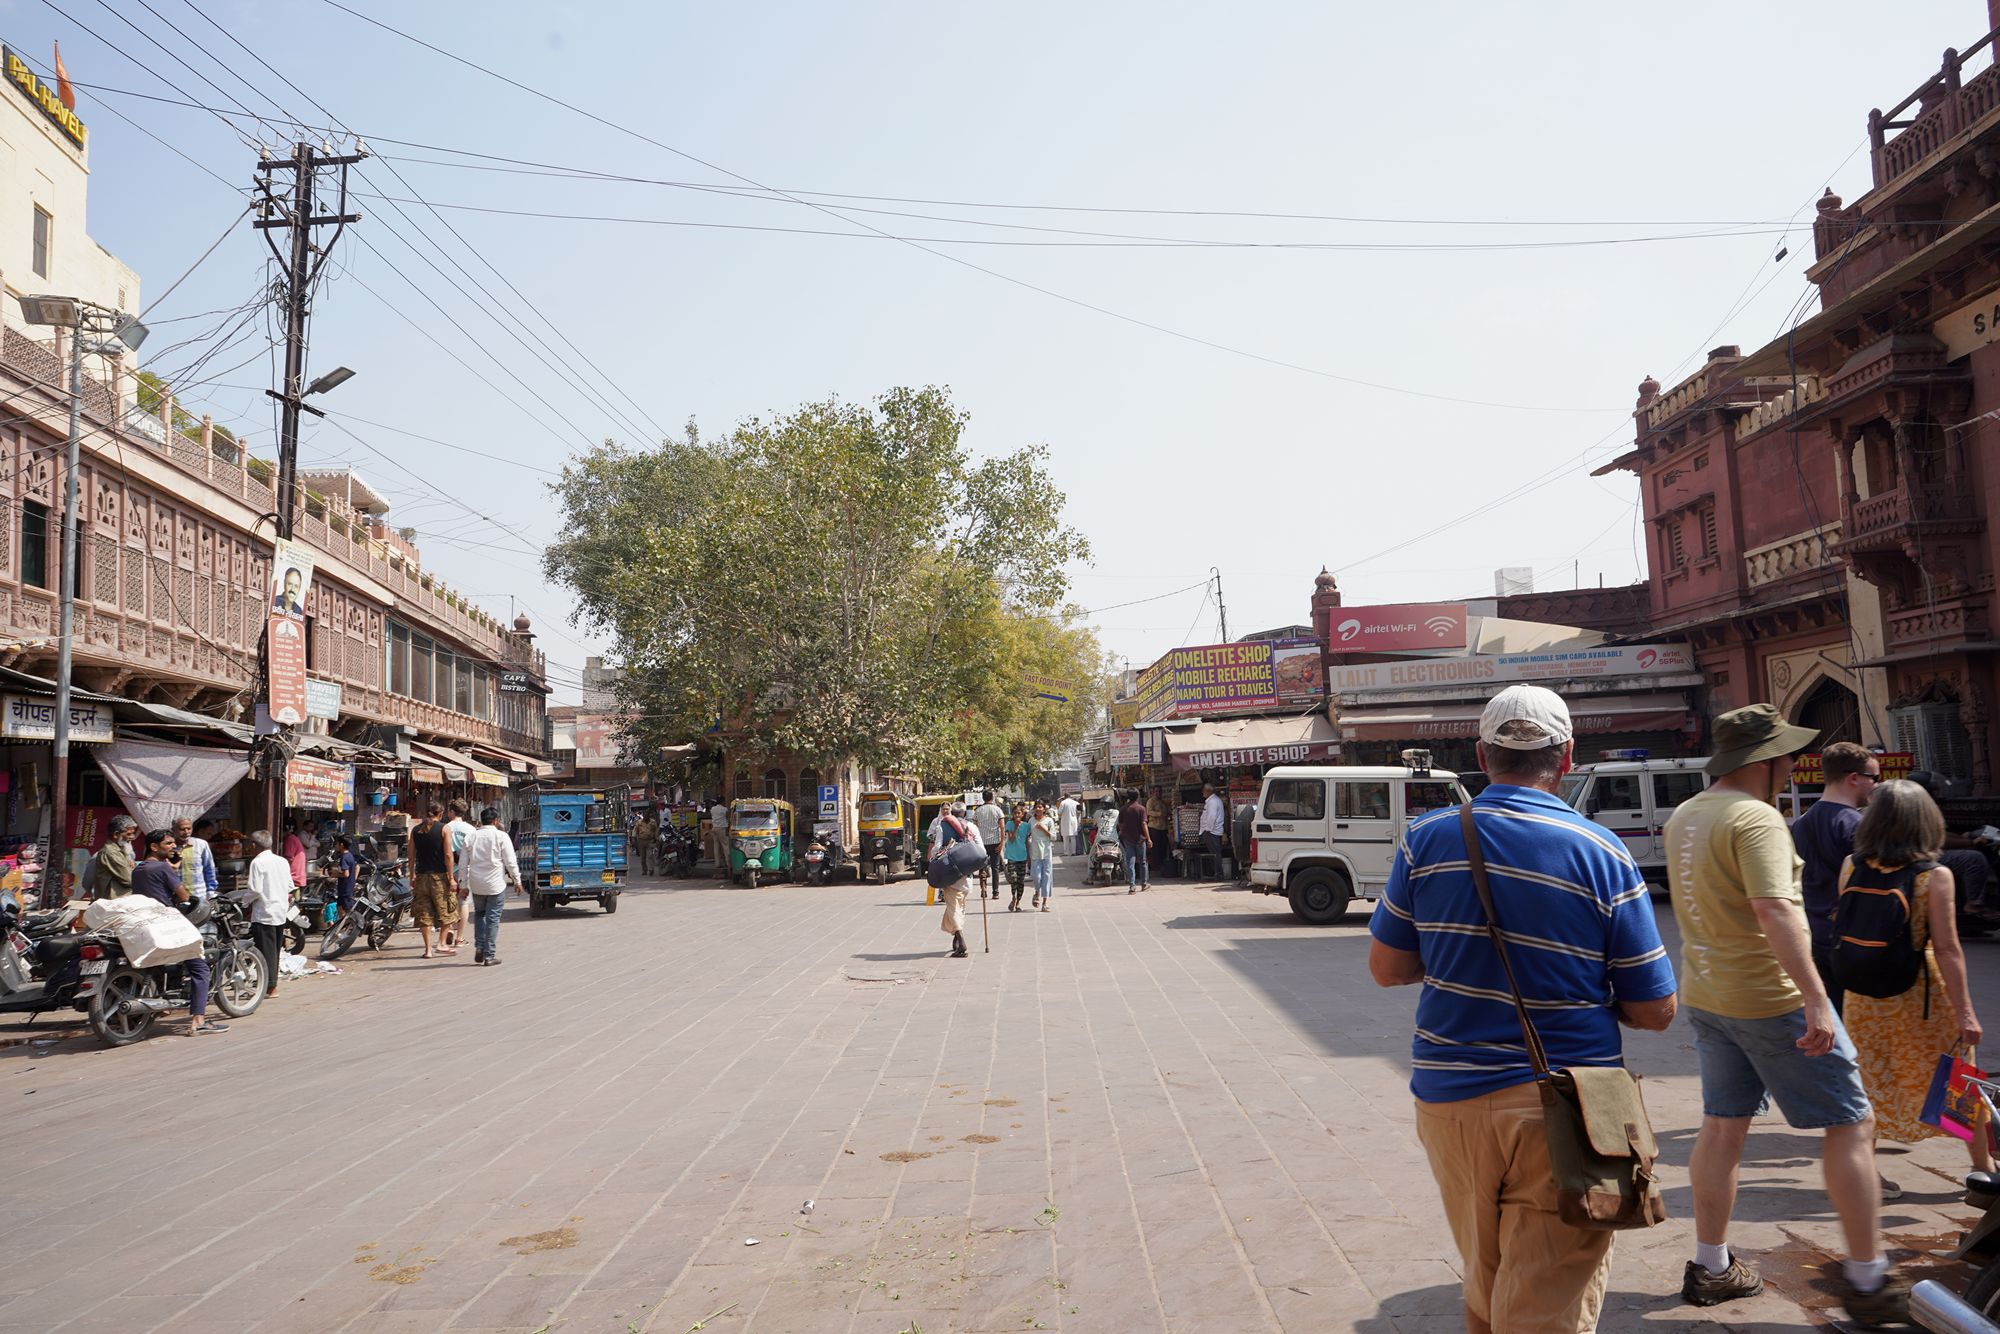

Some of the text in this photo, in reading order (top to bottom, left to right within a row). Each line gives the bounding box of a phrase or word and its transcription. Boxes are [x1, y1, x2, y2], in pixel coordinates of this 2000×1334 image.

[8, 54, 85, 144] PAL HAVELI
[1364, 623, 1417, 634] airtel Wi-Fi
[1174, 645, 1271, 669] OMELETTE SHOP
[1508, 656, 1529, 664] INDIAN
[1530, 655, 1553, 663] MOBILE
[1569, 652, 1587, 660] CARD
[1588, 650, 1623, 659] AVAILABLE
[1024, 674, 1072, 690] FAST FOOD POINT
[1175, 664, 1273, 686] MOBILE RECHARGE
[1336, 659, 1495, 688] LALIT ELECTRONICS
[500, 684, 527, 692] BISTRO
[1176, 686, 1203, 701] NAMO
[1203, 684, 1227, 699] TOUR
[1227, 684, 1235, 697] &
[1236, 681, 1275, 697] TRAVELS
[1440, 721, 1480, 735] ELECTR
[1189, 745, 1310, 767] OMELETTE SHOP
[823, 787, 835, 800] P
